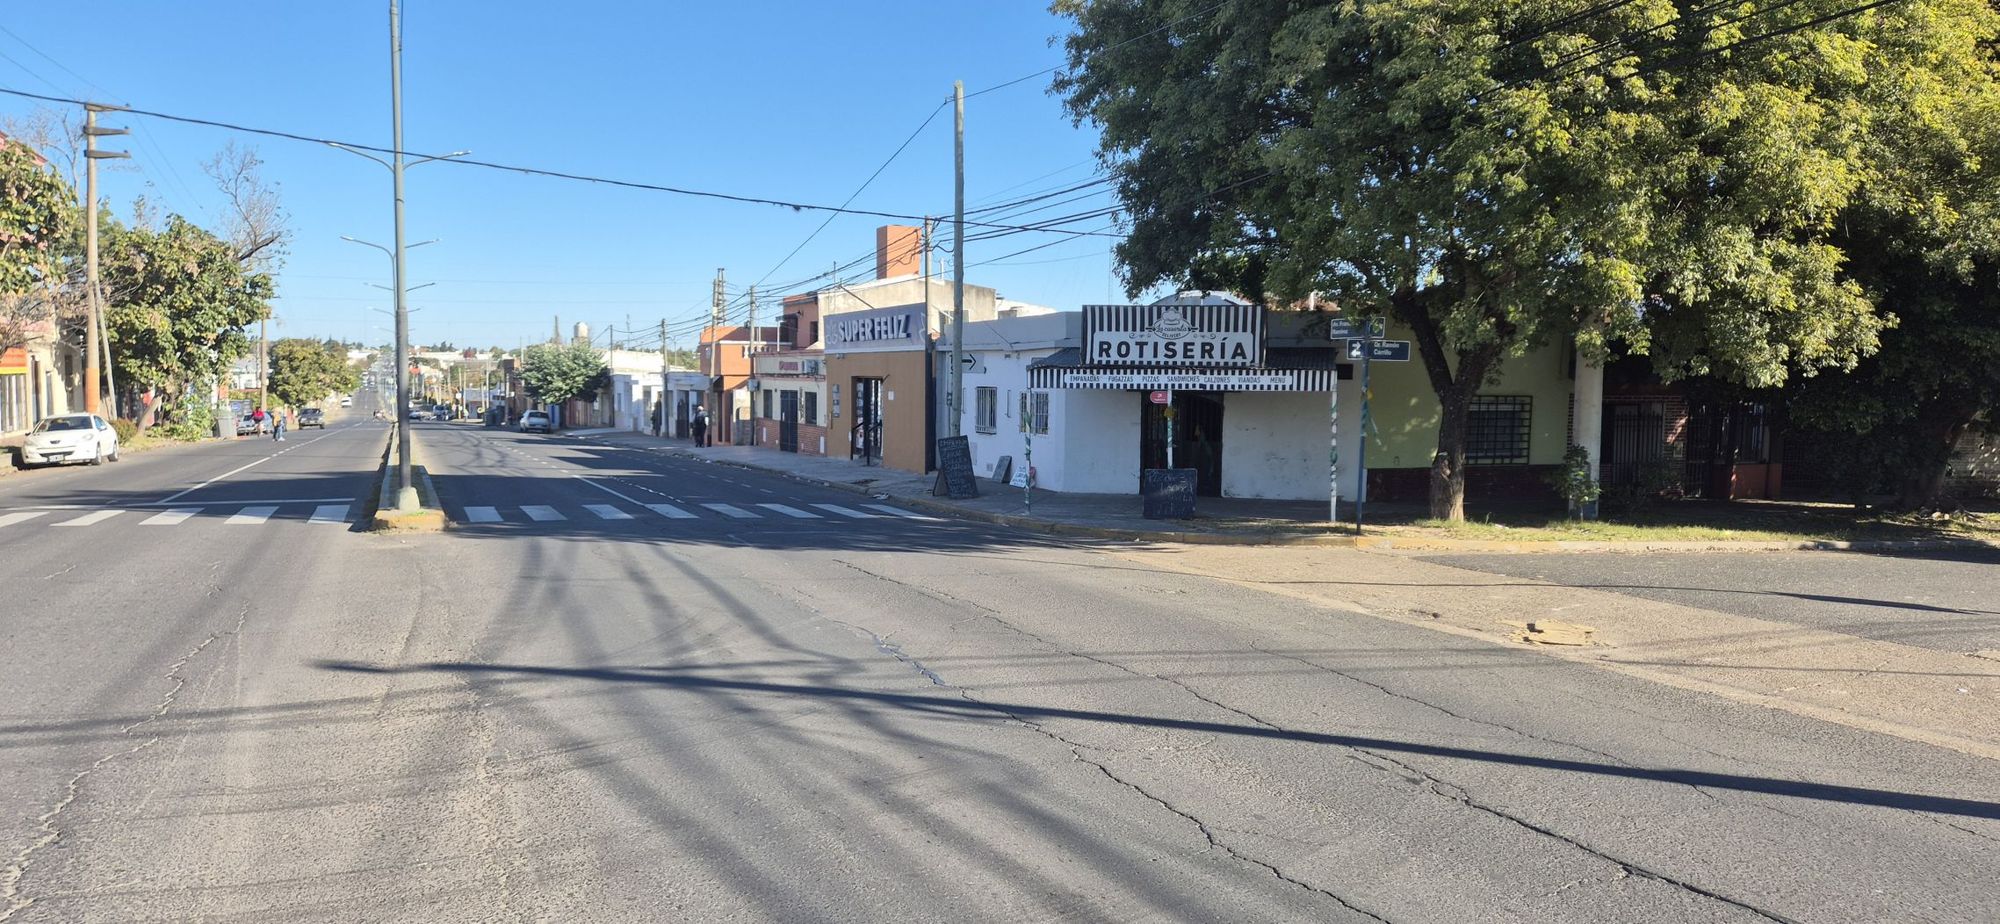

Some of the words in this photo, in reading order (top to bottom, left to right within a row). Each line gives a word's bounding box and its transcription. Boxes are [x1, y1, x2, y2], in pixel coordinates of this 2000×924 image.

[839, 318, 874, 341] SUPER
[874, 314, 908, 340] FELIZ
[1098, 336, 1248, 360] ROTISERÍA
[1166, 375, 1201, 383] SANDWICHES
[1238, 376, 1261, 384] VIANDAS
